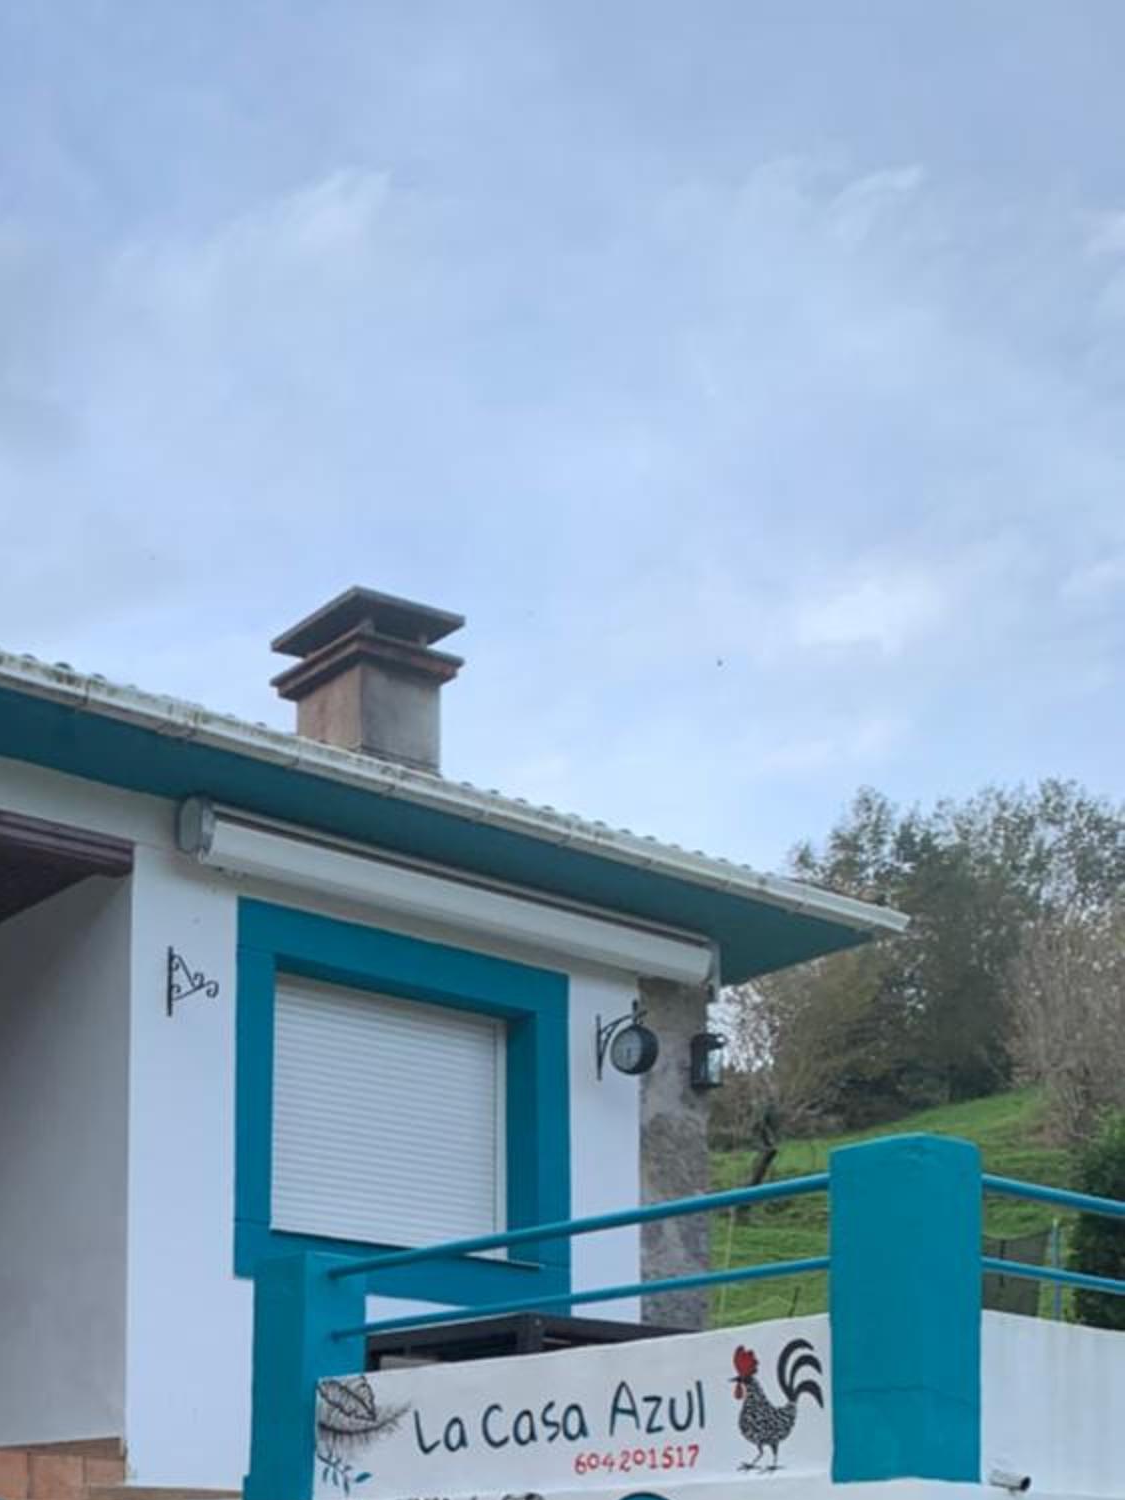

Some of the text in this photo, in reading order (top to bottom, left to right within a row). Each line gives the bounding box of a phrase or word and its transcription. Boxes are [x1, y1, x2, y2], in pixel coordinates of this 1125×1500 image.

[413, 1380, 706, 1455] La Casa Azul
[574, 1443, 700, 1475] 604201517
